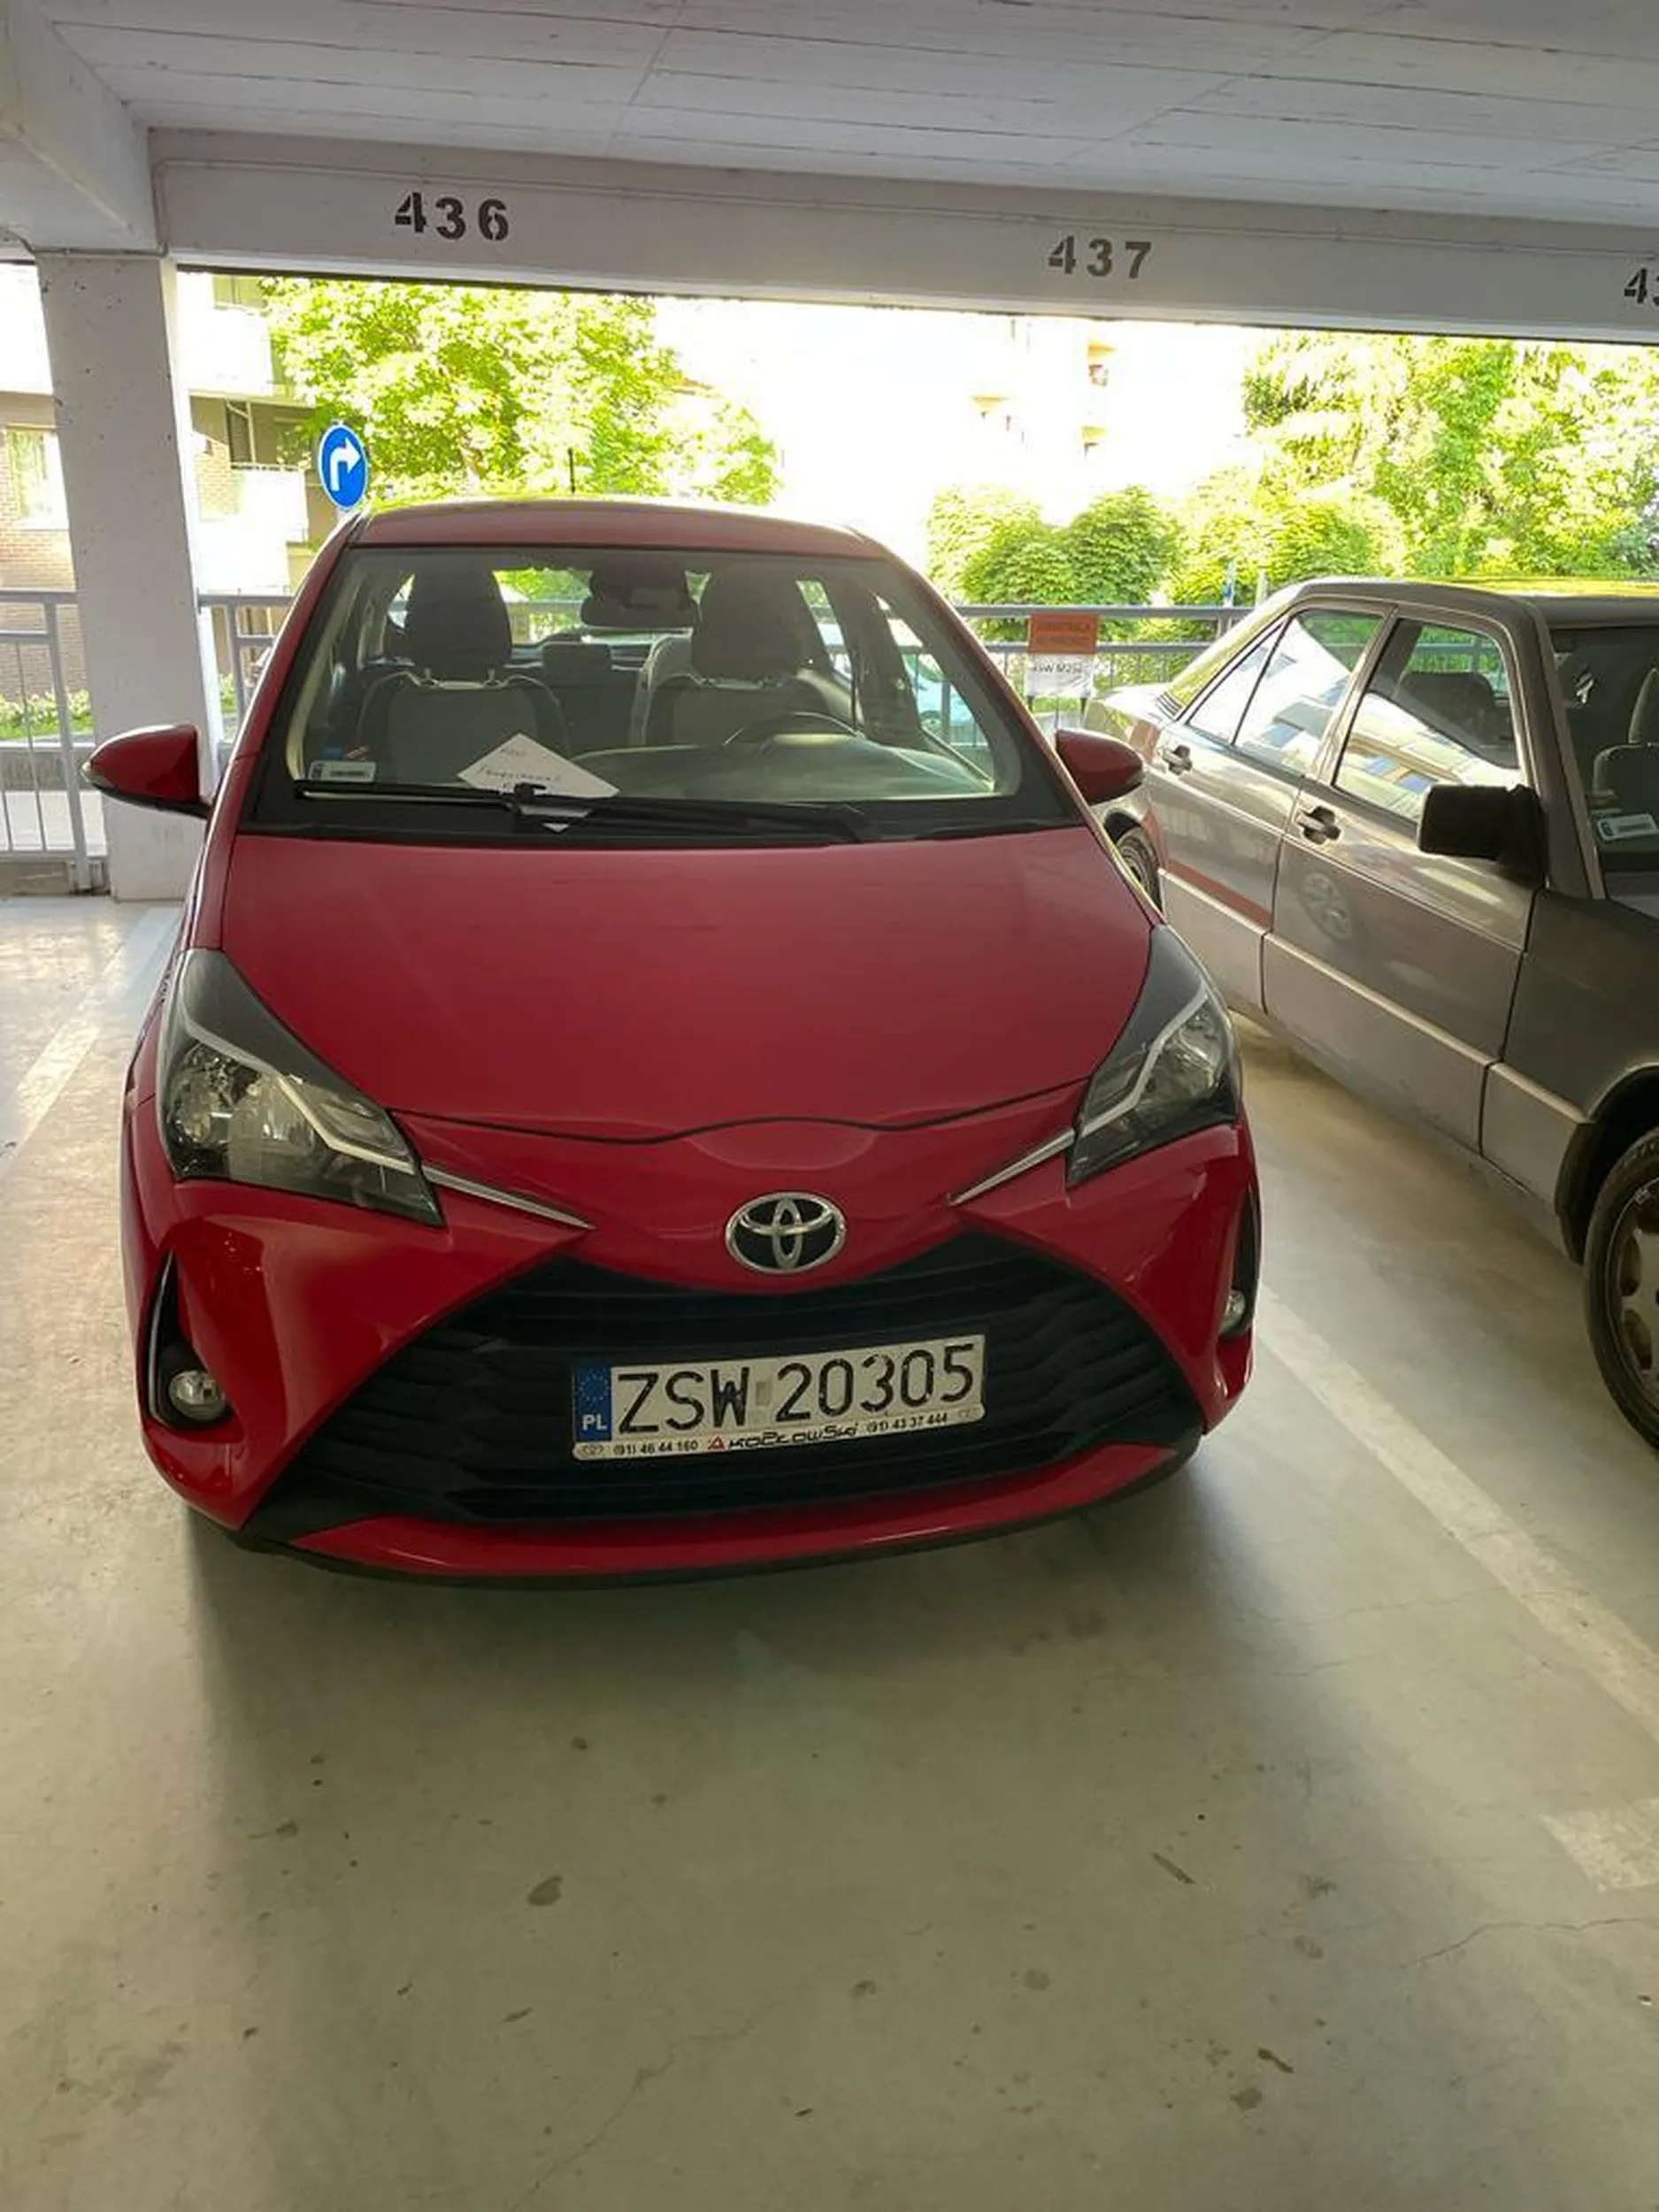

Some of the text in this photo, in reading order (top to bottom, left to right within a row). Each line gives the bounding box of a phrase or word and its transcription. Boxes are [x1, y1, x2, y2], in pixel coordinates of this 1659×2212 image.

[395, 191, 509, 242] 436
[1048, 235, 1152, 280] 437
[1624, 267, 1659, 307] 4
[618, 1343, 974, 1434] ZSW 20305
[582, 1414, 608, 1432] PL
[657, 1441, 672, 1453] 44
